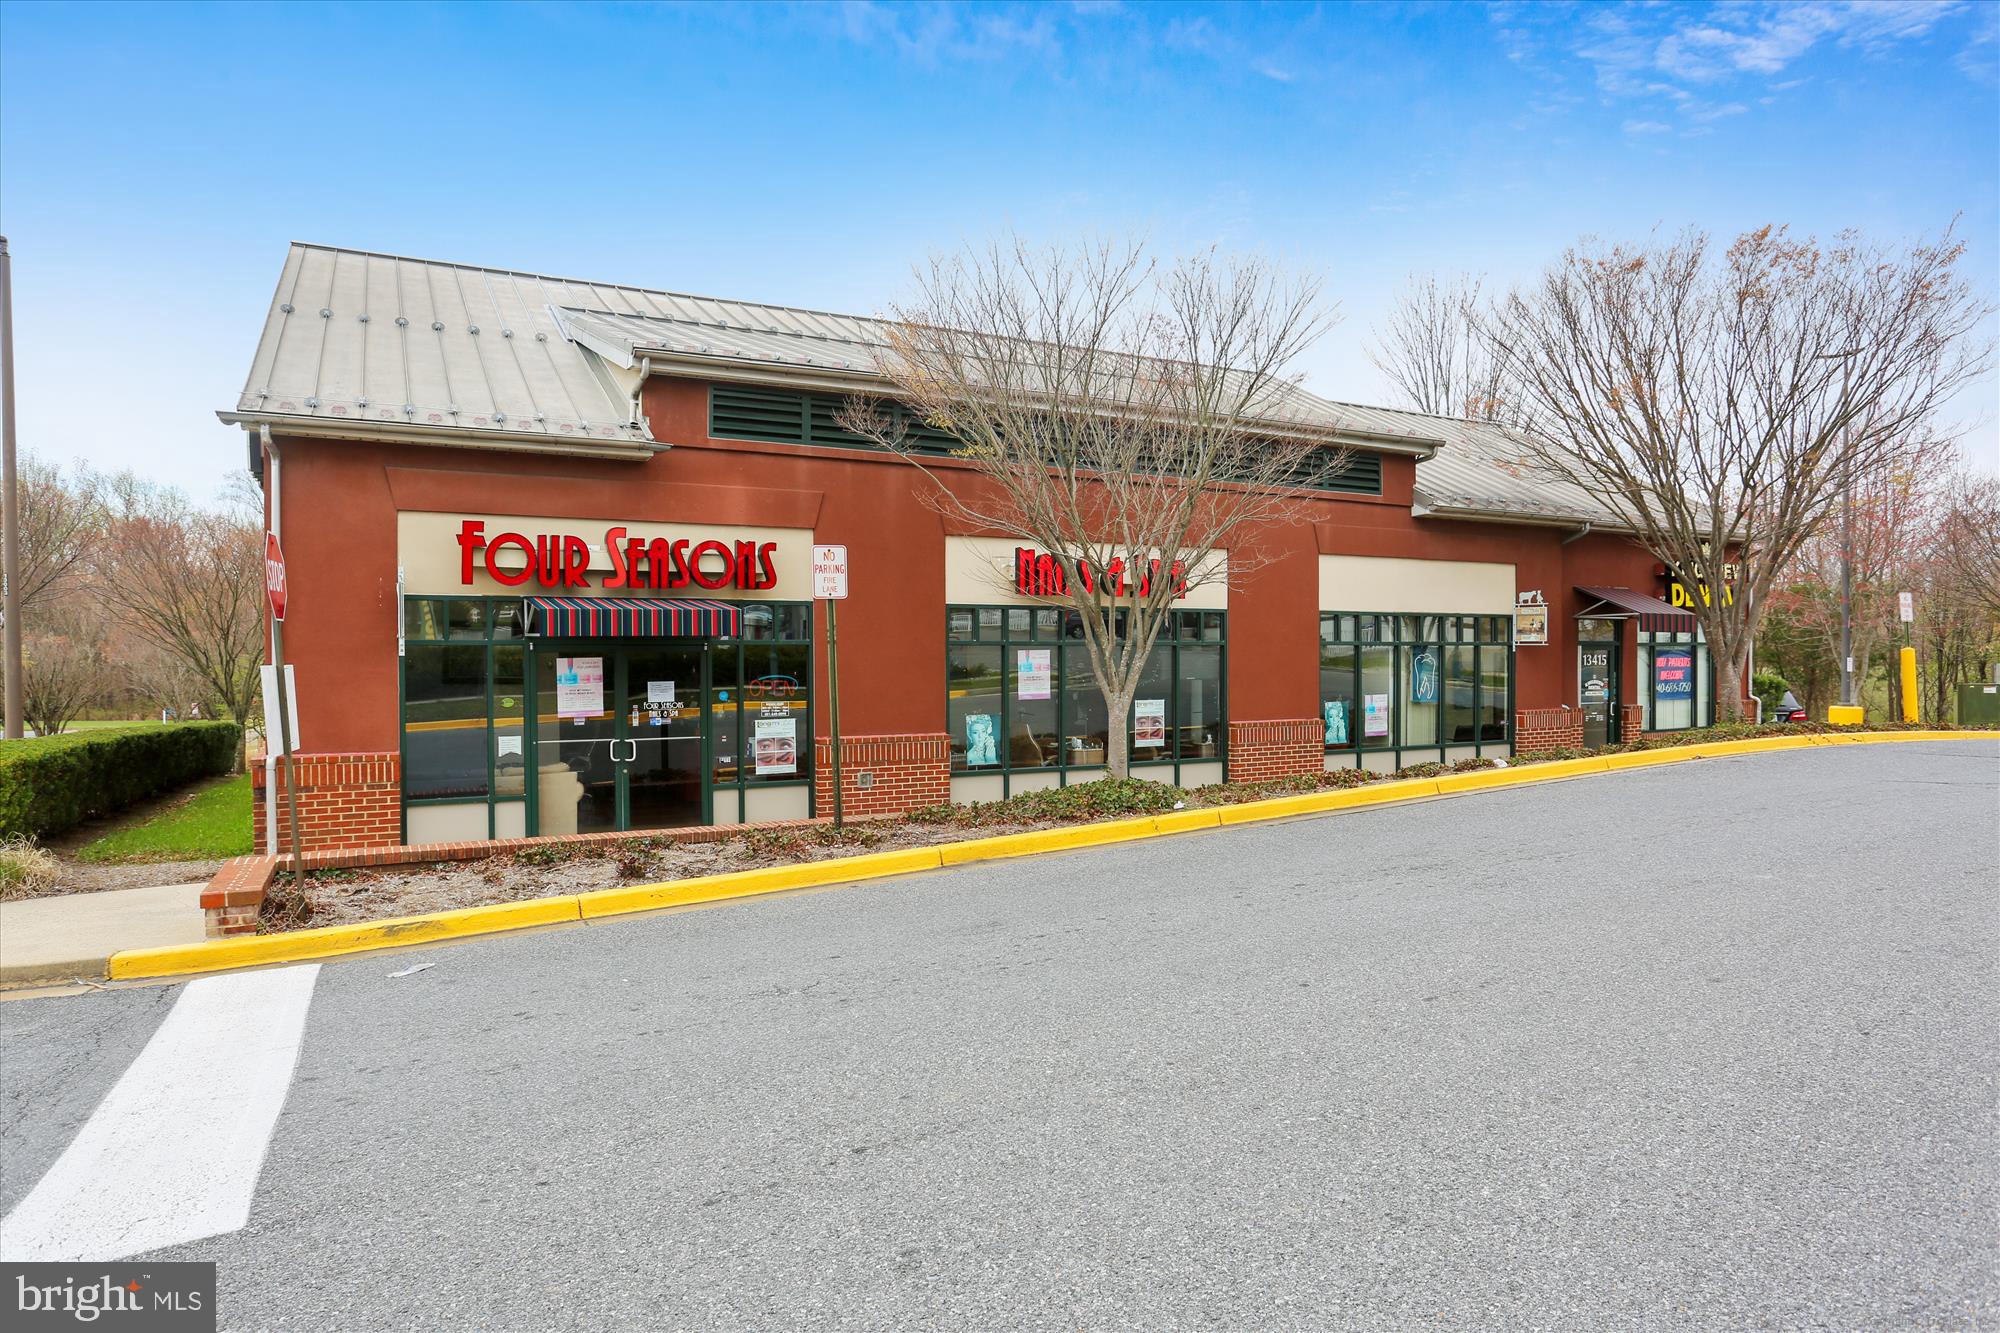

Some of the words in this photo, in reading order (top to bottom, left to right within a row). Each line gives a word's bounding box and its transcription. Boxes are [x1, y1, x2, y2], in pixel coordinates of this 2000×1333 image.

[823, 551, 836, 561] NO
[814, 564, 845, 574] PARKING
[267, 559, 284, 593] STOP
[823, 576, 837, 584] FIRE
[822, 585, 838, 593] LANE
[1583, 654, 1607, 666] 13415
[750, 679, 795, 697] OPEN
